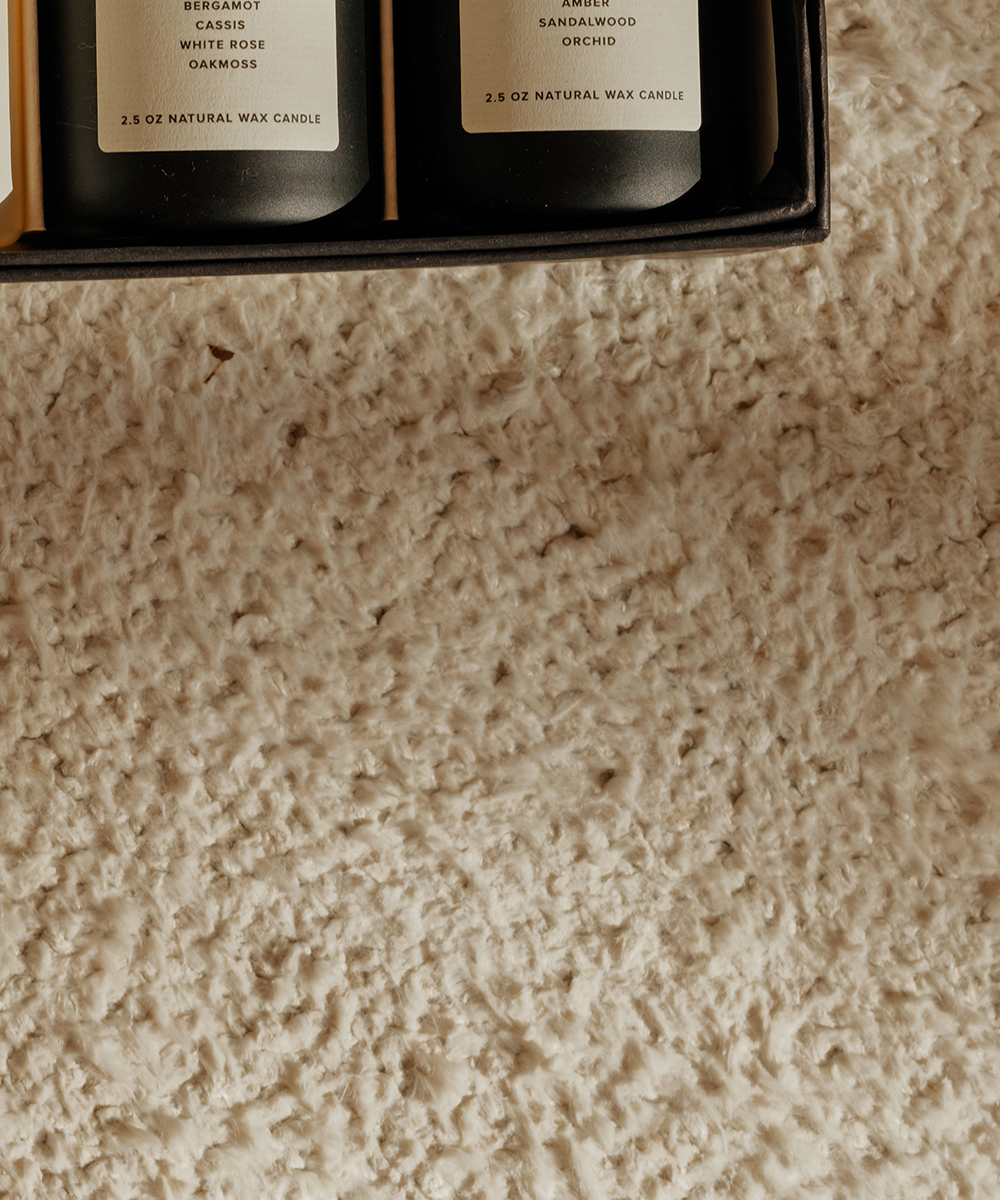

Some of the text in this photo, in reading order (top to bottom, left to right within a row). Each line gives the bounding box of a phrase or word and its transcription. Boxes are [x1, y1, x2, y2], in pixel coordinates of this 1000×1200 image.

[183, 0, 261, 12] BERGAMOT
[195, 19, 246, 31] CASSIS
[538, 16, 637, 28] SANDALWOOD
[179, 39, 266, 50] WHITE ROSE
[561, 35, 617, 47] ORCHID
[188, 58, 258, 70] OAKMOSS
[485, 89, 684, 103] 2.5 OZ NATURAL WAX CANDLE
[120, 112, 321, 126] 2.5 OZ NATURAL WAX CANDLE
